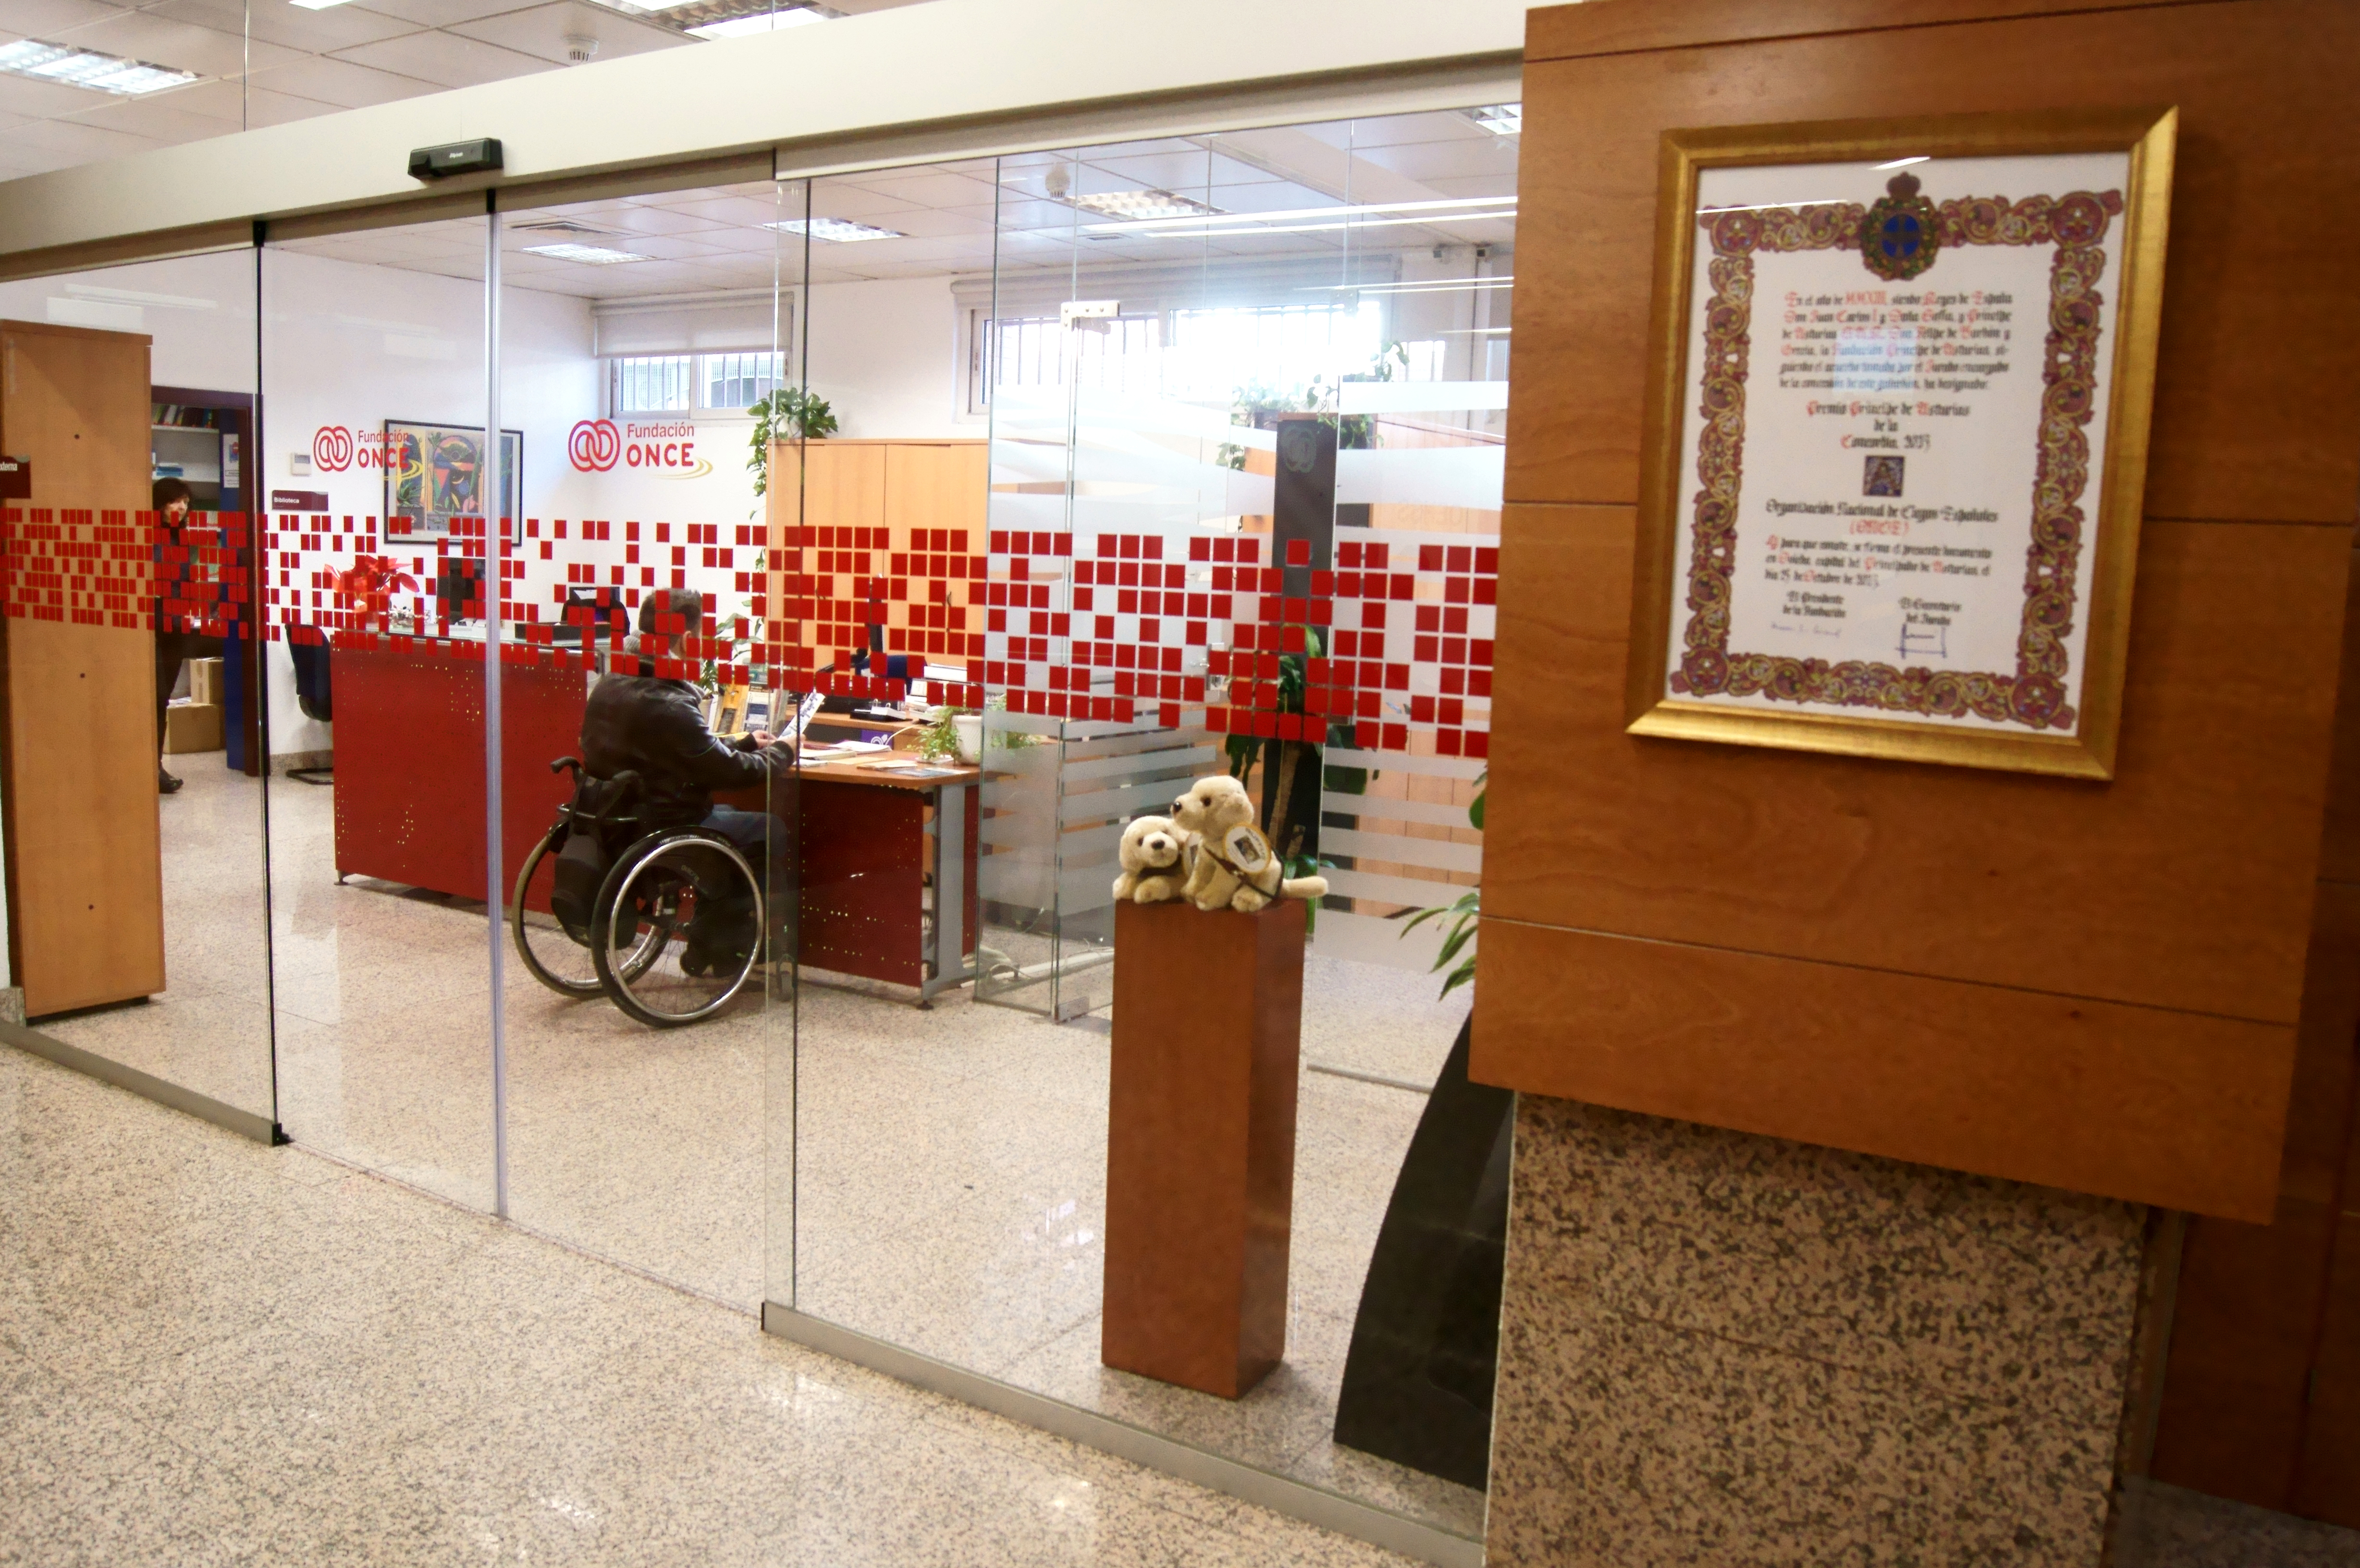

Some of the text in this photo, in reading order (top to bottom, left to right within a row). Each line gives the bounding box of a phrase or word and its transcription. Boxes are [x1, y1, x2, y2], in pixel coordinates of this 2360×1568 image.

[358, 429, 409, 442] Fundación
[627, 421, 694, 438] Fundación
[357, 447, 409, 468] ONCE
[627, 443, 694, 467] ONCE
[0, 461, 18, 471] xterna
